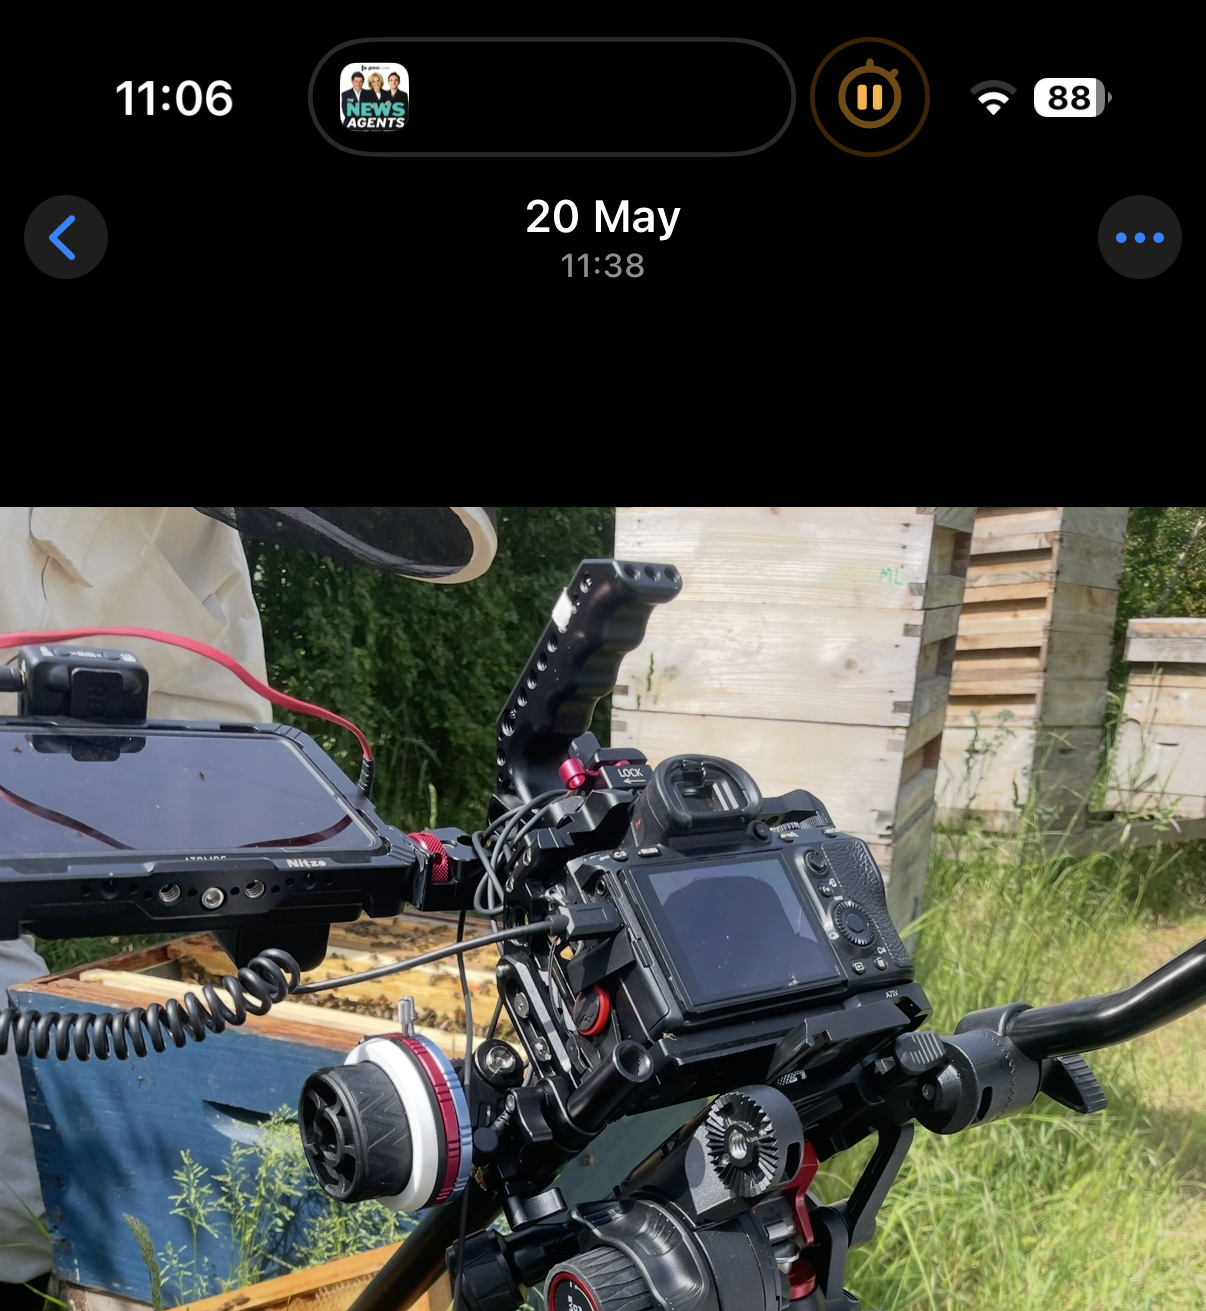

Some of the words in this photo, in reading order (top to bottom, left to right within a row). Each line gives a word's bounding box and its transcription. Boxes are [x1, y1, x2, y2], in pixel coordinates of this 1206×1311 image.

[116, 79, 233, 117] 11:06
[346, 102, 406, 117] NEWS
[1048, 84, 1091, 111] 88
[346, 117, 406, 129] AGENTS
[526, 199, 579, 234] 20
[595, 199, 682, 242] May
[561, 252, 645, 279] 11:38
[617, 767, 644, 778] LOCK
